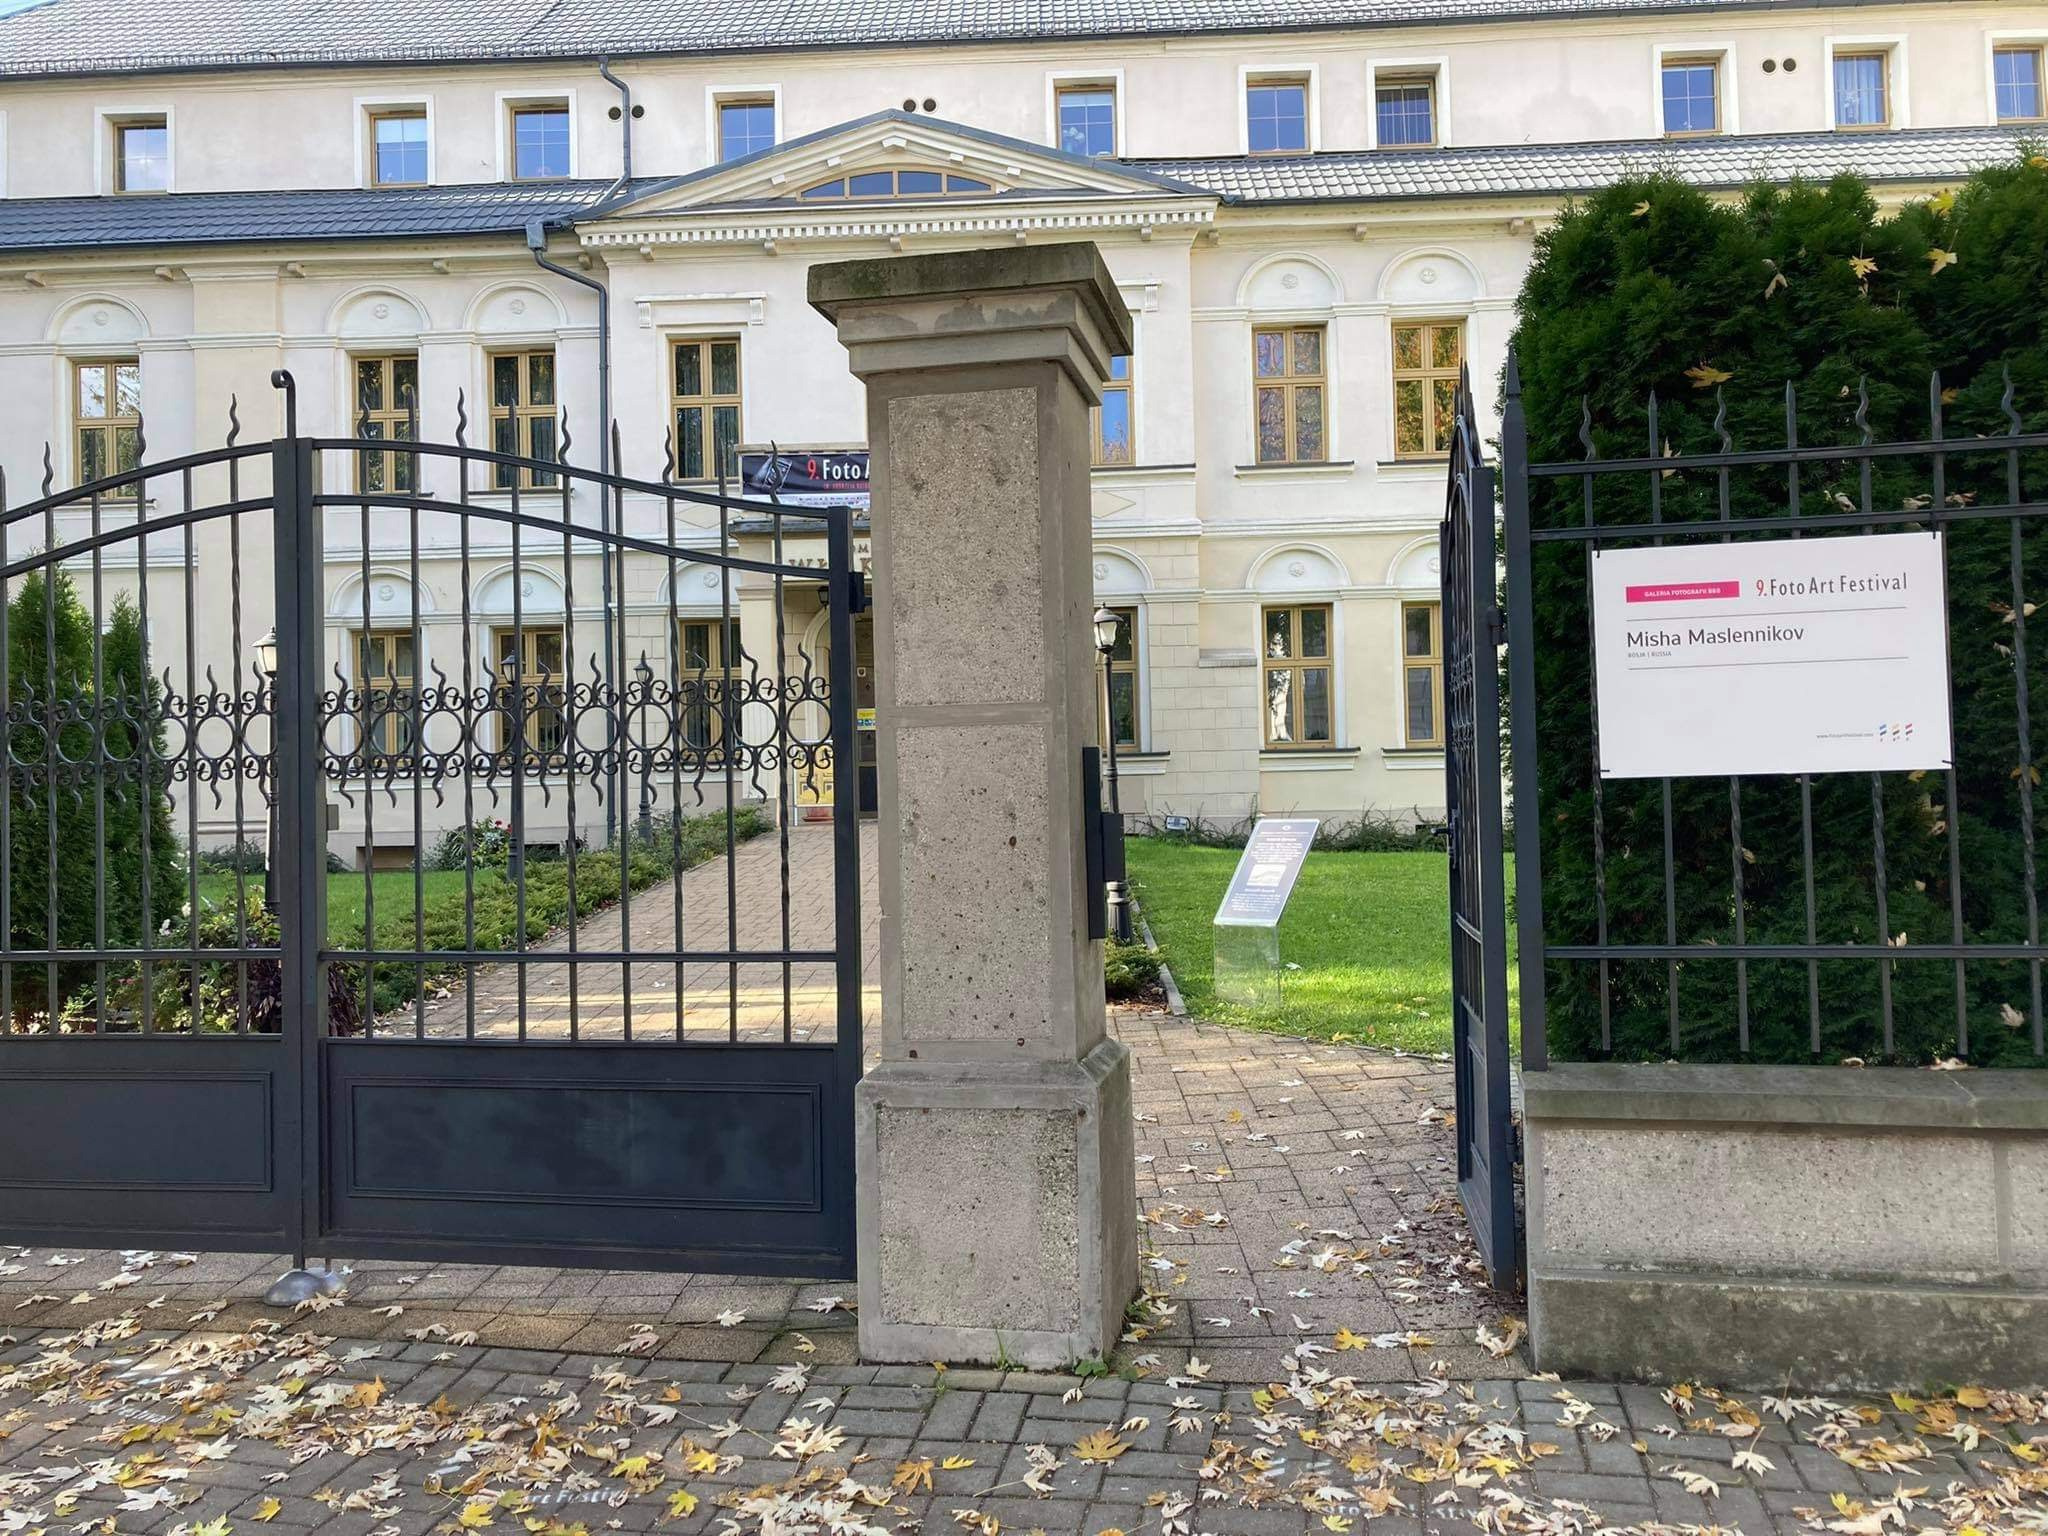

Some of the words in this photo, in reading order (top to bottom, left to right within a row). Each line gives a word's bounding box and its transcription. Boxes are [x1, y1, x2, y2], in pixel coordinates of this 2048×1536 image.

[822, 459, 862, 480] Foto
[1840, 572, 1907, 593] Festival
[1643, 589, 1671, 598] GALERIA
[1627, 630, 1681, 648] Misha
[1688, 625, 1804, 646] Maslennikov
[1651, 650, 1672, 658] RUSSIA
